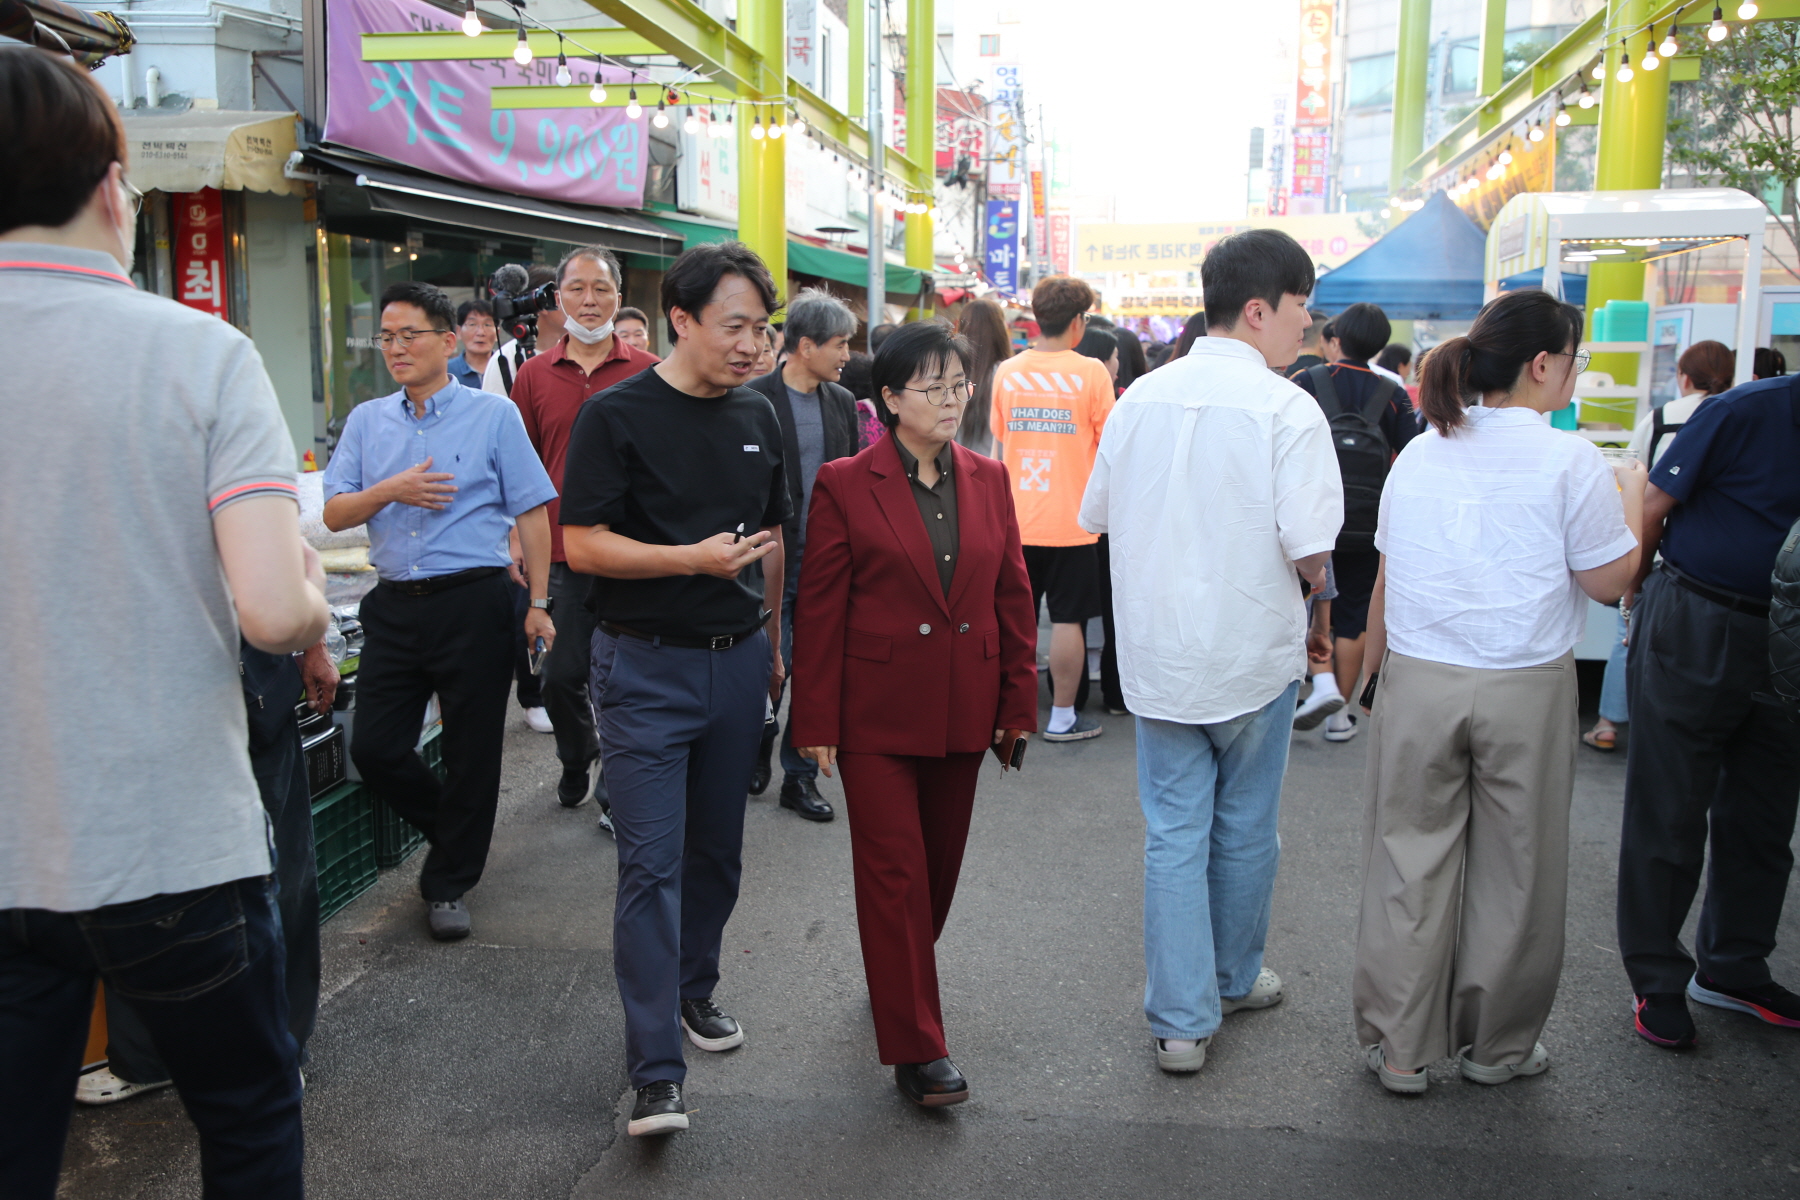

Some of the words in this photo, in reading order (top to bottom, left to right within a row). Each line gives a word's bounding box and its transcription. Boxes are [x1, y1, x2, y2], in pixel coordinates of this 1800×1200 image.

[368, 62, 473, 153] 커트
[488, 109, 639, 192] 9,900원
[1042, 408, 1071, 421] DOES
[1026, 421, 1077, 434] MEAN?!?!
